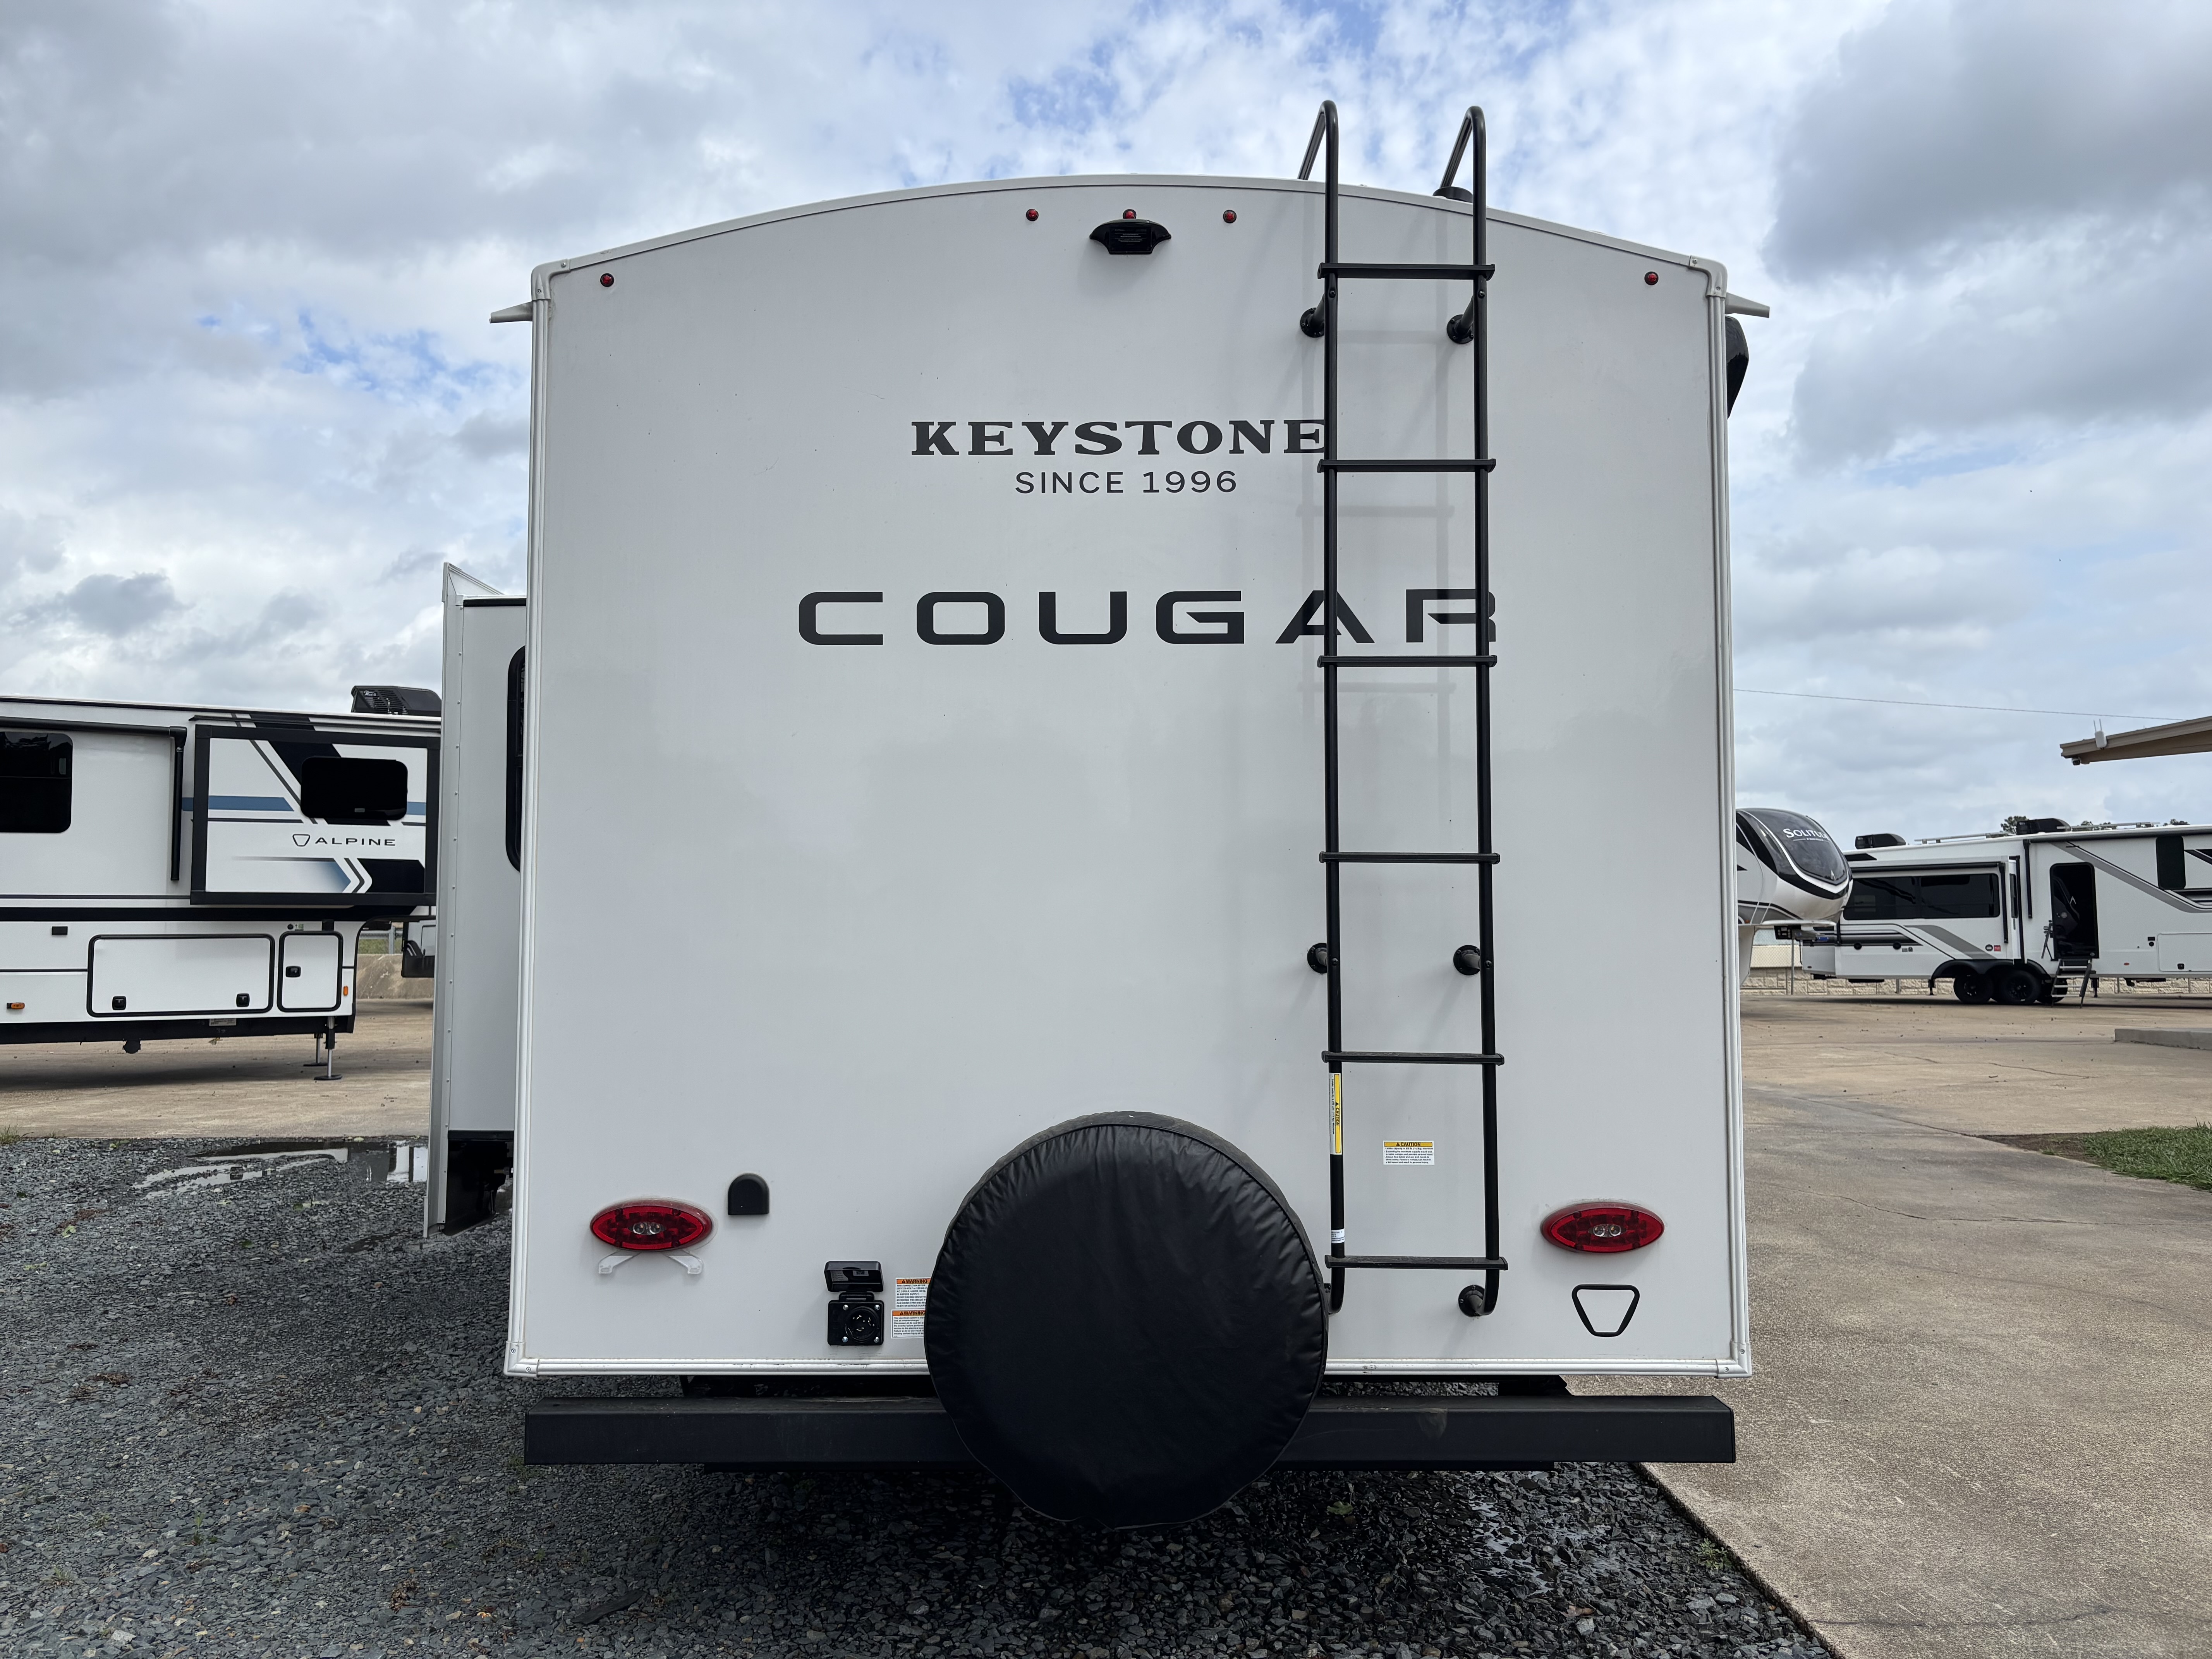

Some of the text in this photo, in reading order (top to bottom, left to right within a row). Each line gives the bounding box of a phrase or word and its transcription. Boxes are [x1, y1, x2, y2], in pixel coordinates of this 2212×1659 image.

[912, 419, 1324, 456] KEYSTONE
[1015, 471, 1237, 494] SINCE 1996
[799, 588, 1496, 645] COUGAR
[315, 837, 395, 846] ALPINE
